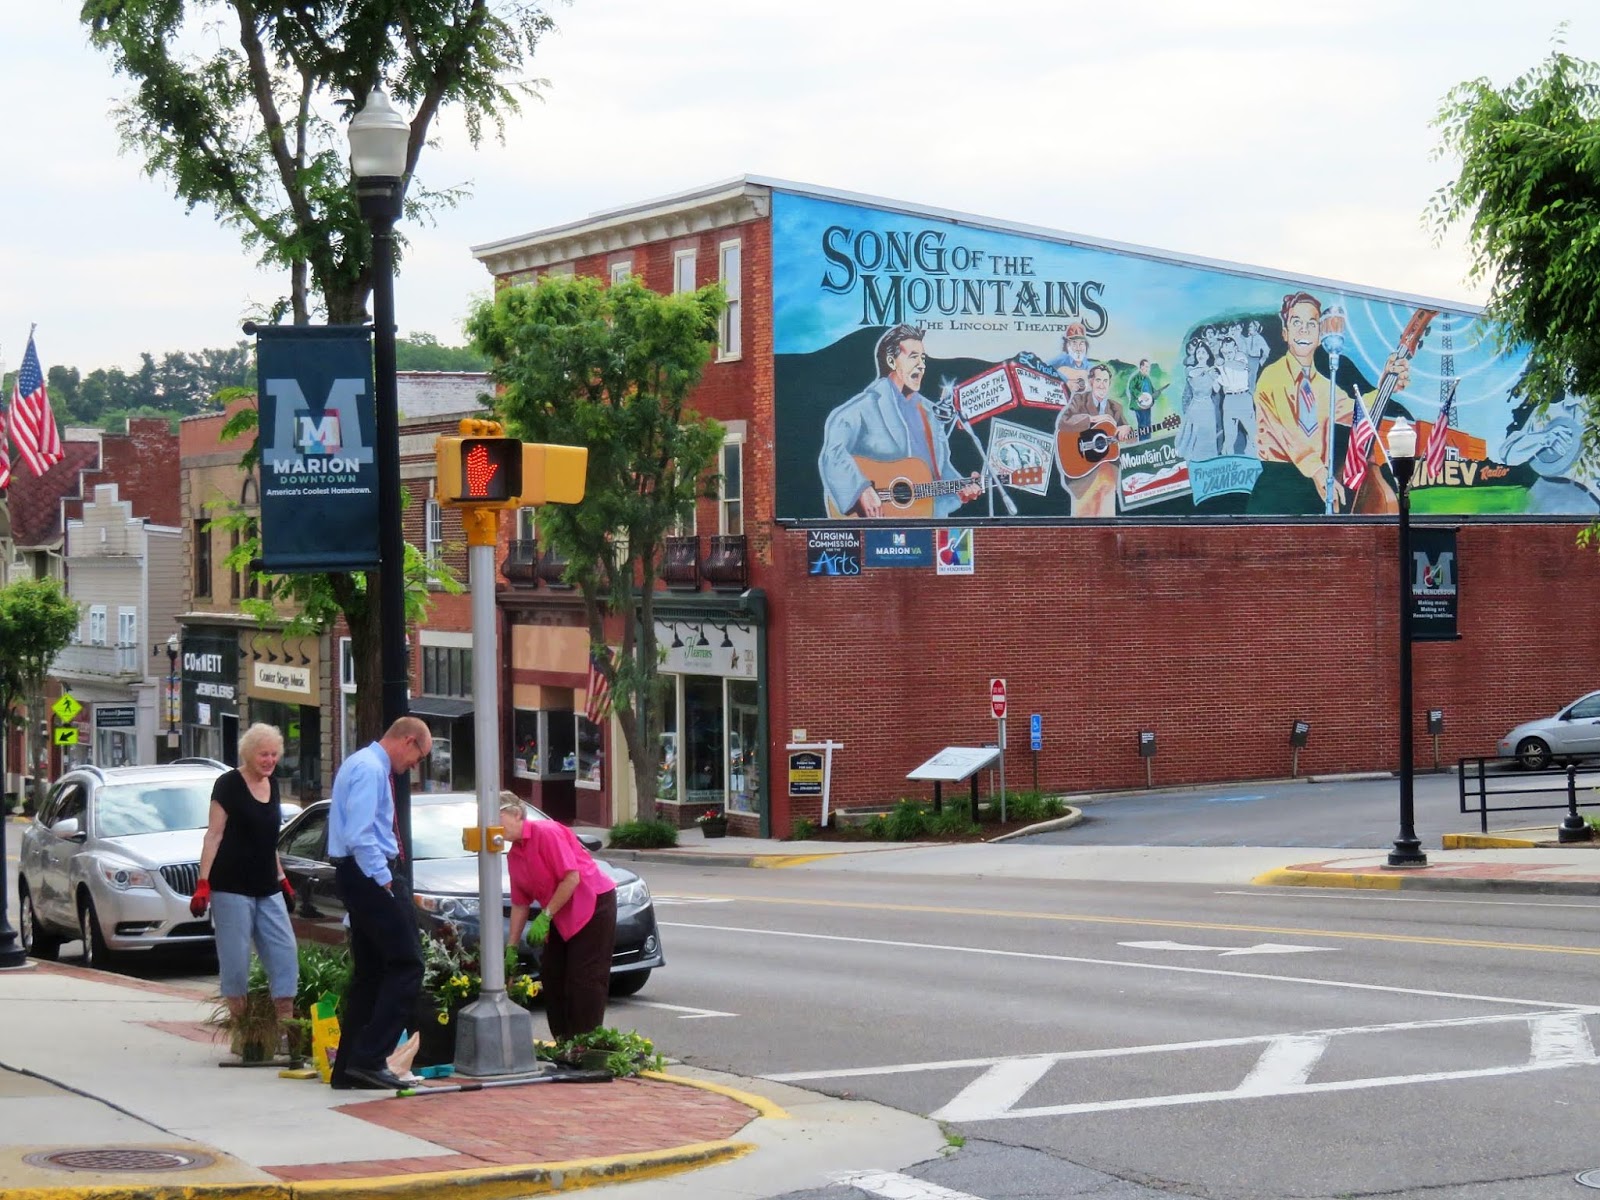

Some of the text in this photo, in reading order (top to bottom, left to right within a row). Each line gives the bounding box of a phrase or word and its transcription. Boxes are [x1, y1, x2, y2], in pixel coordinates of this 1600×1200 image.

[820, 225, 1036, 295] SONG OF THE
[859, 274, 1108, 337] MOUNTAINS
[915, 319, 943, 330] THE
[950, 320, 1009, 331] LINCOLN
[961, 374, 1006, 399] SONG OF THE
[969, 395, 1000, 414] TONIGHT
[273, 457, 360, 474] MARION
[1121, 448, 1162, 470] Mountain
[280, 475, 356, 484] DOWNTOWN
[1480, 465, 1510, 481] Radio
[266, 487, 371, 496] America's Coolest Hometown.
[809, 540, 859, 548] COMMISSION
[812, 531, 854, 541] VIRGINIA
[876, 547, 922, 555] MARION VA
[810, 550, 859, 575] Arts
